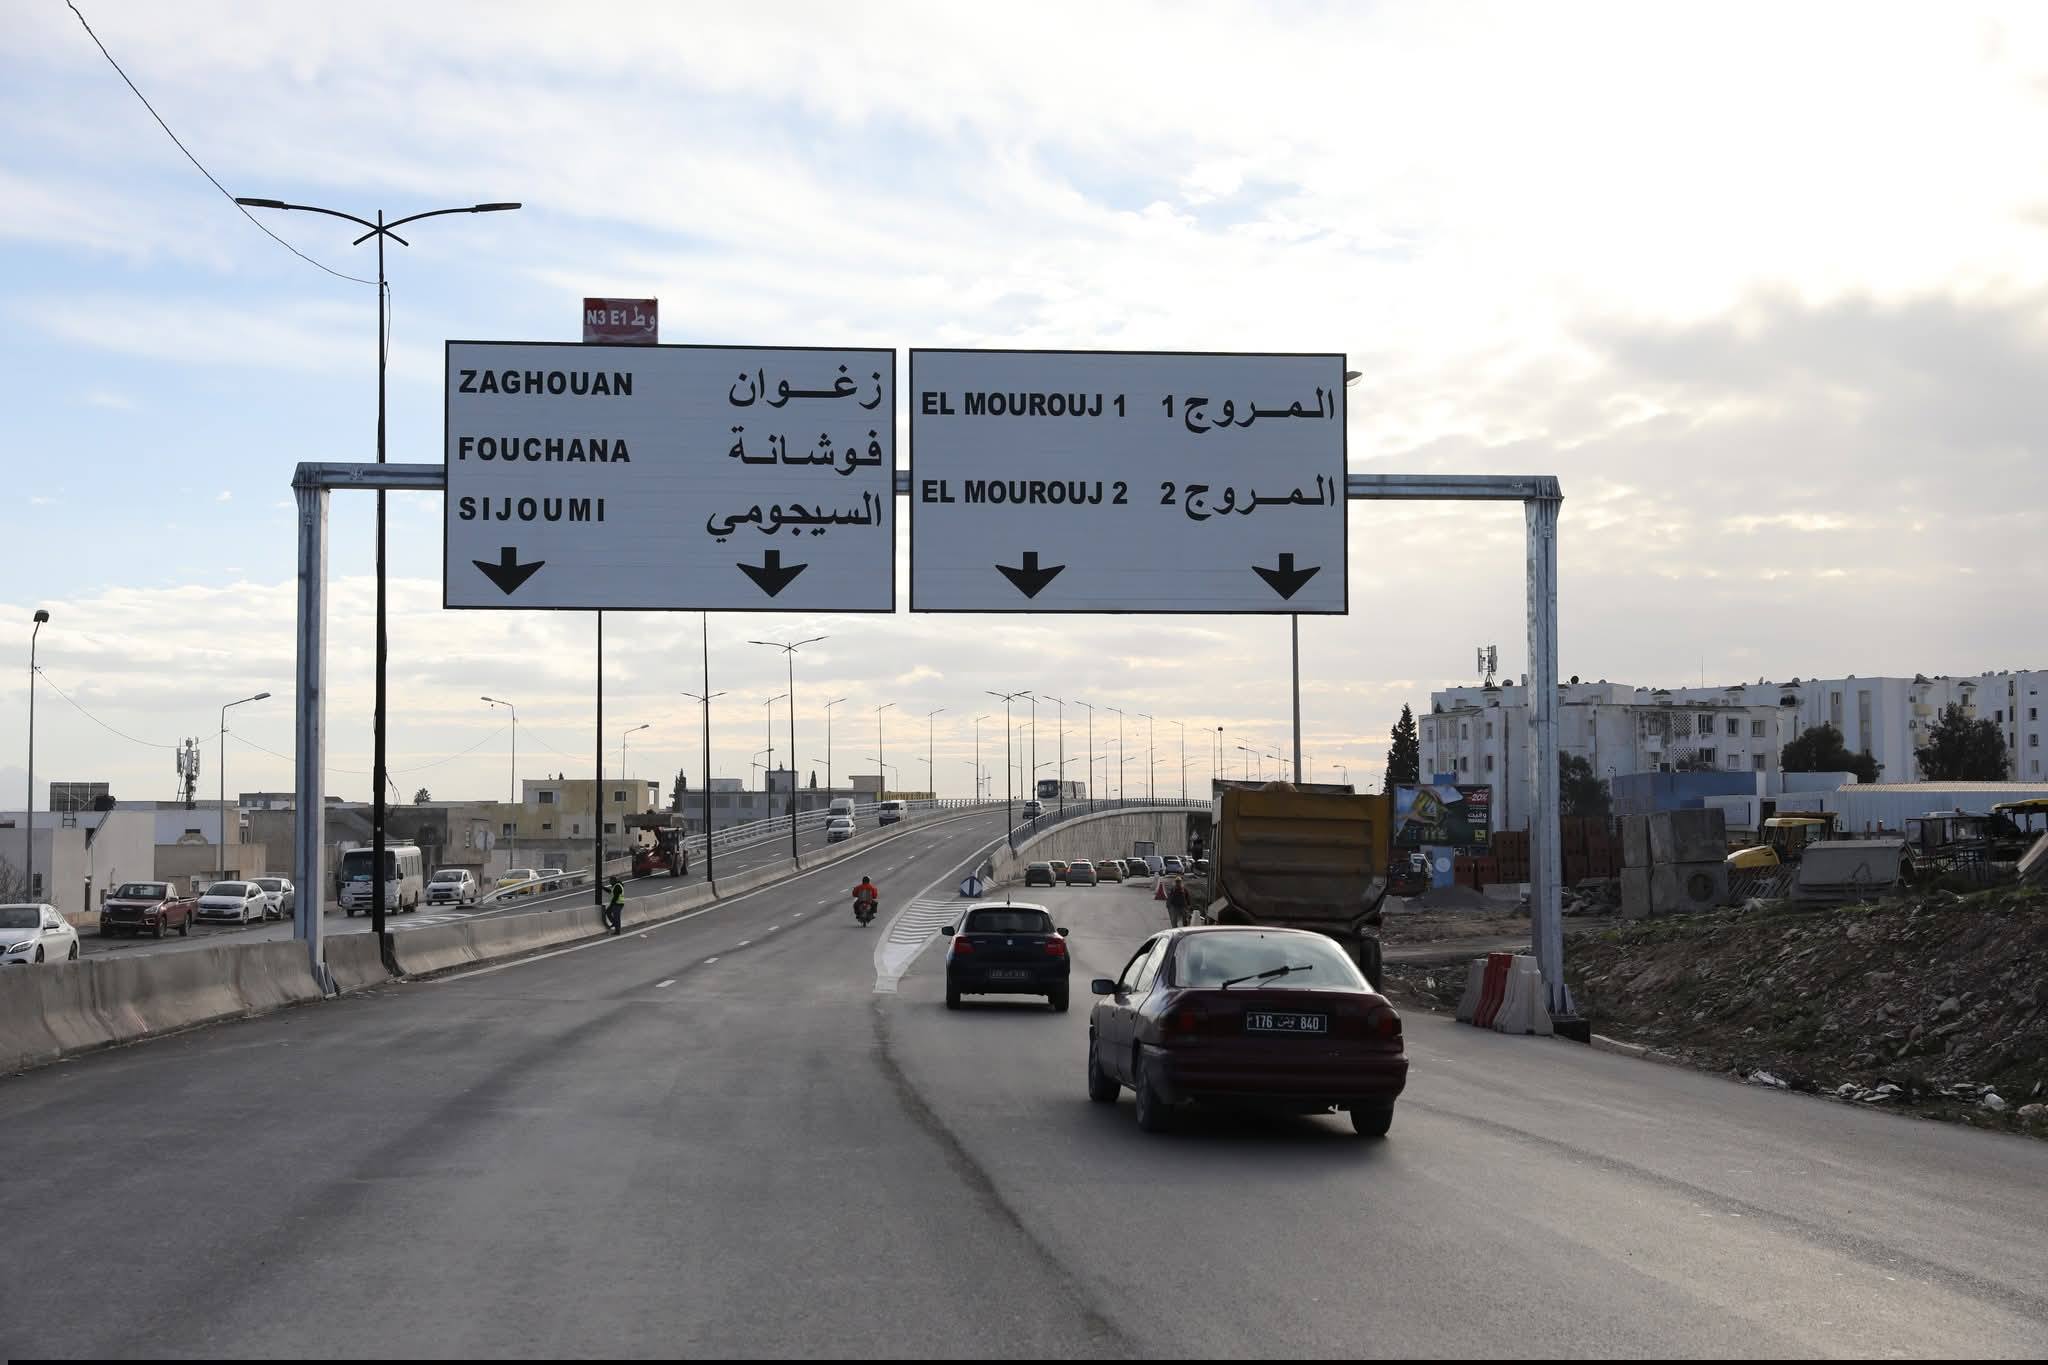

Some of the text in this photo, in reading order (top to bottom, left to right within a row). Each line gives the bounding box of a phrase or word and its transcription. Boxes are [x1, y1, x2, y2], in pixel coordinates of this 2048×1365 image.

[587, 309, 606, 326] N3
[610, 310, 627, 326] E1
[458, 369, 633, 396] ZAGHOUAN
[728, 364, 882, 410] زغوان
[921, 391, 1126, 418] EL MOUROUJ 1
[1161, 386, 1335, 434] المروج 1
[458, 436, 631, 463] FOUCHANA
[728, 425, 882, 476] فوشانة
[922, 479, 1128, 505] EL MOUROUJ 2
[1160, 473, 1335, 522] المروج 2
[458, 496, 605, 522] SIJOUMI
[706, 490, 882, 544] السيجومي
[1255, 1015, 1274, 1029] 176
[1300, 1016, 1320, 1031] 840
